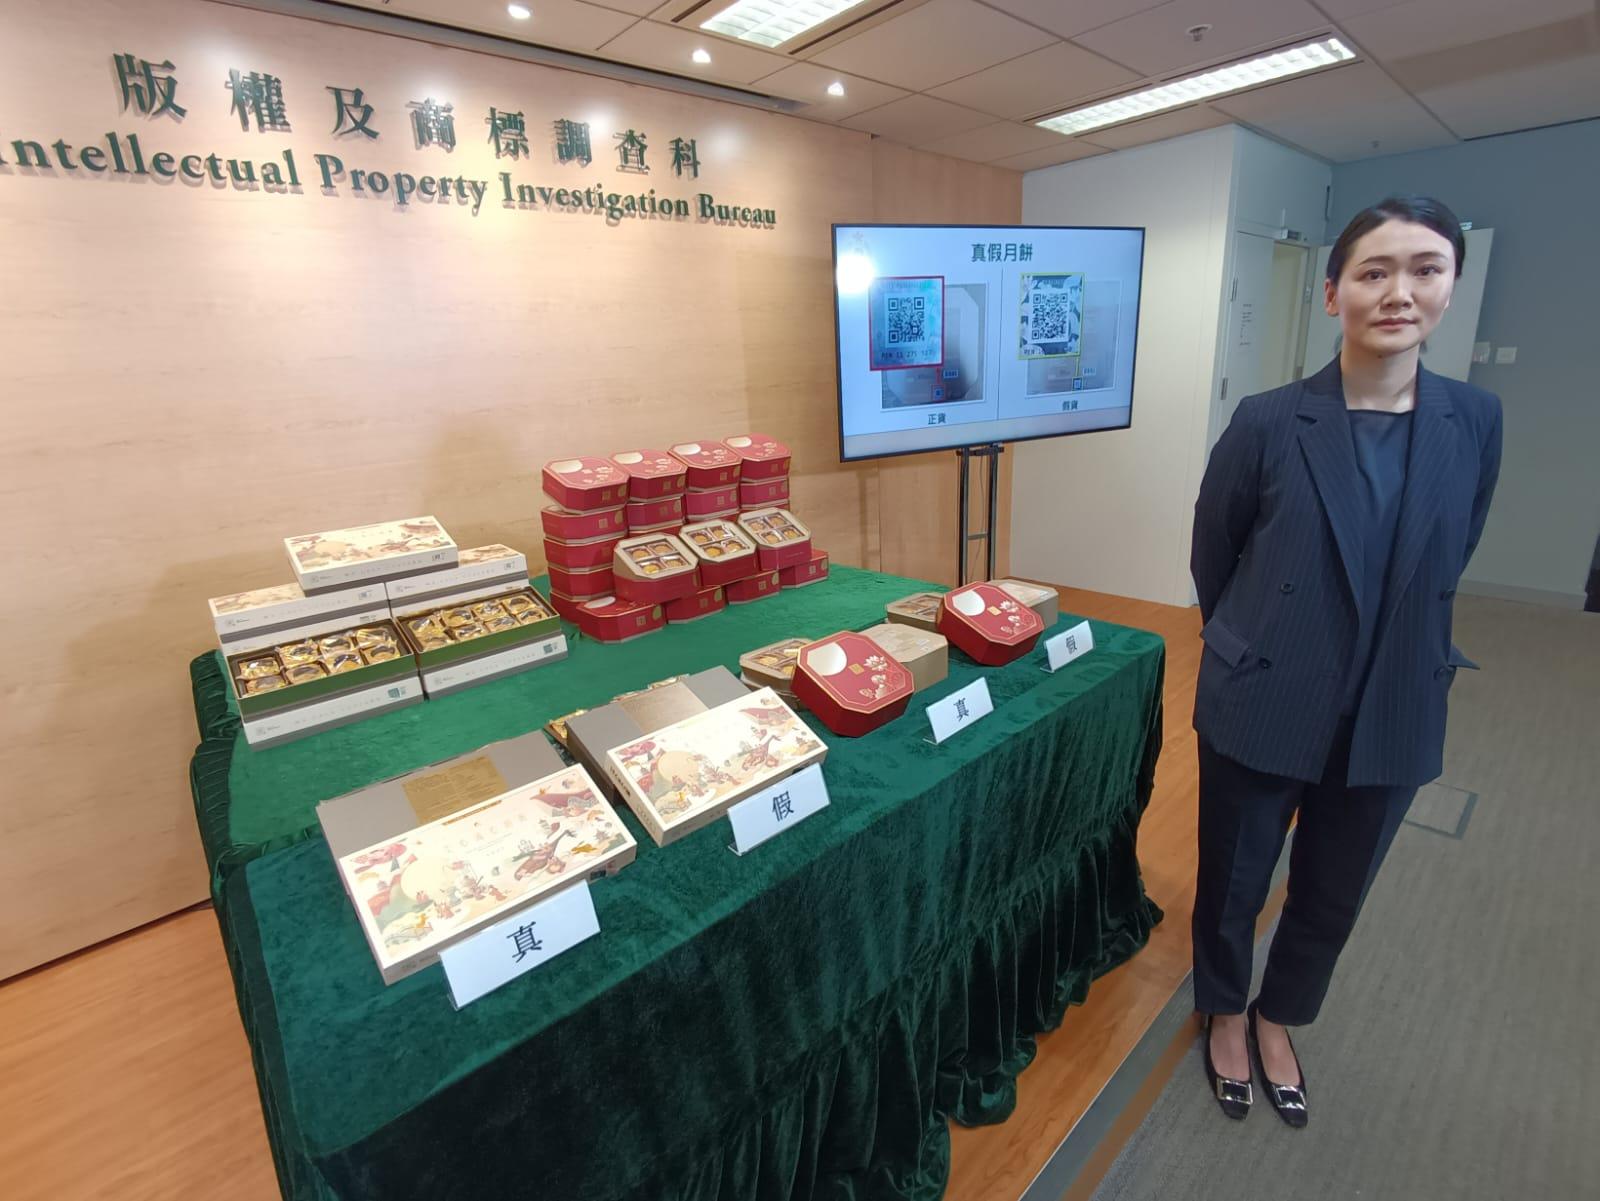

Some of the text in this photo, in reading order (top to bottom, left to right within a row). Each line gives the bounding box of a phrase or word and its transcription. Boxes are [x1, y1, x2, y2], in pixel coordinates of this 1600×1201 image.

[113, 52, 700, 178] 版權及商標調查科
[0, 132, 776, 225] ntellectual Property Investigation Bureau
[971, 242, 1033, 262] 真假月餅
[953, 697, 969, 722] 真
[771, 790, 795, 822] 假
[506, 921, 544, 963] 真
